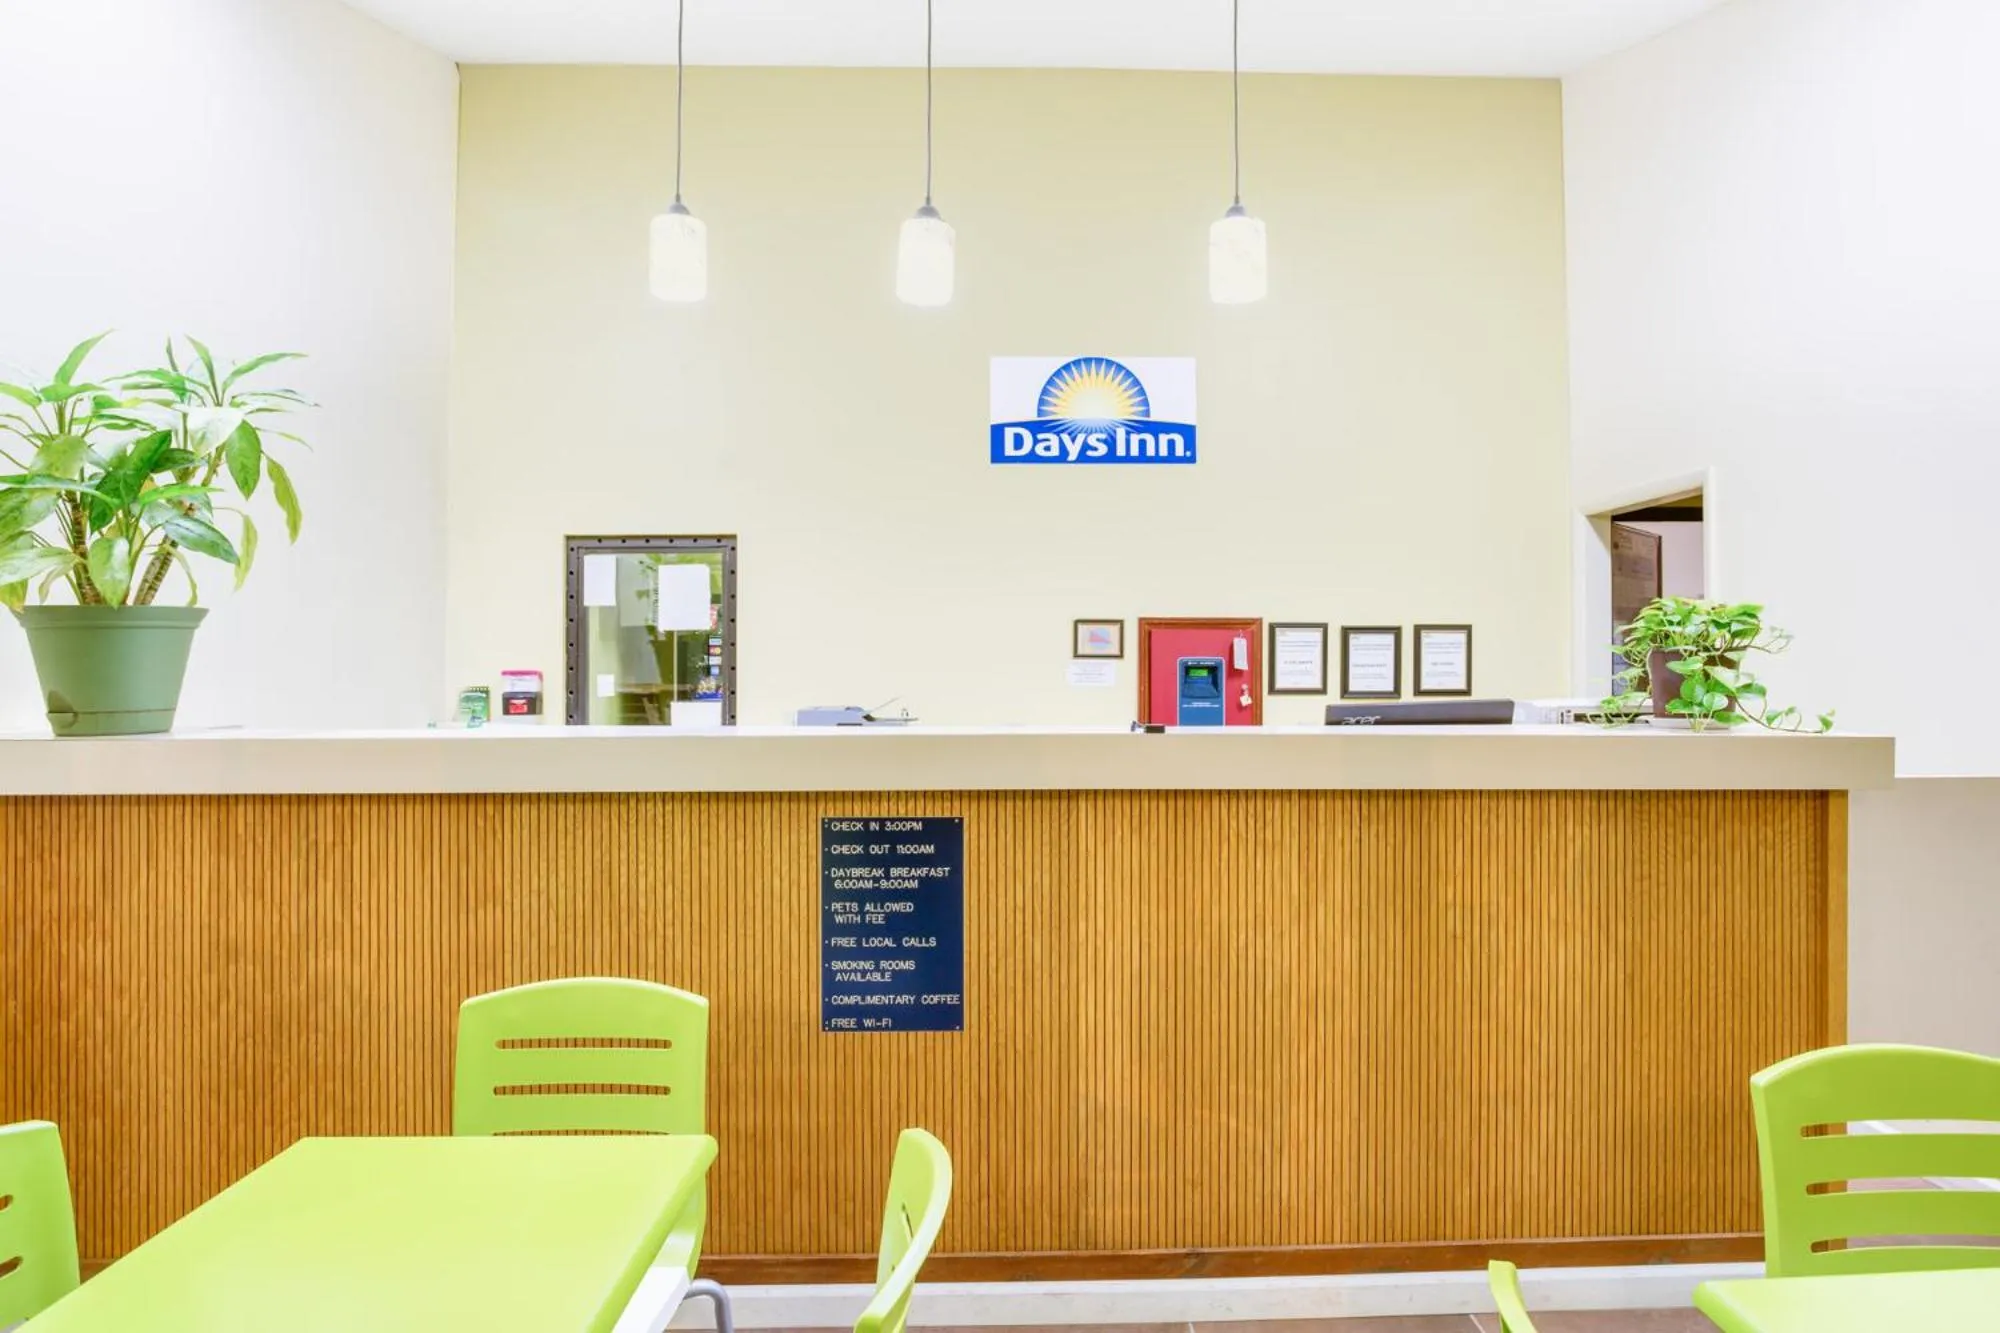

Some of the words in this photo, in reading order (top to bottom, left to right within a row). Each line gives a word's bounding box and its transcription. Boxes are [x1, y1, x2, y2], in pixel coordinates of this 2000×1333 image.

[1004, 427, 1109, 461] Days
[1342, 715, 1381, 725] acer
[831, 820, 864, 831] CHECK
[870, 820, 879, 831] IN
[885, 820, 922, 831] 3:00PM
[831, 844, 864, 855] CHECK
[869, 844, 890, 855] OUT
[897, 844, 935, 855] 11:00AM
[831, 867, 885, 878] DAYBREAK
[890, 867, 951, 878] BREAKFAST
[831, 901, 858, 913] PETS
[864, 901, 914, 913] ALLOWED
[834, 913, 860, 925] WITH
[866, 913, 885, 925] FEE
[831, 936, 857, 948] FREE
[862, 936, 897, 948] LOCAL
[902, 936, 937, 948] CALLS
[831, 960, 875, 971] SMOKING
[880, 960, 916, 971] ROOMS
[835, 971, 892, 983] AVAILABLE
[831, 994, 915, 1005] COMPLIMENTARY
[921, 994, 961, 1005] COFFEE
[831, 1018, 857, 1029] FREE
[863, 1018, 892, 1029] WI-FI
